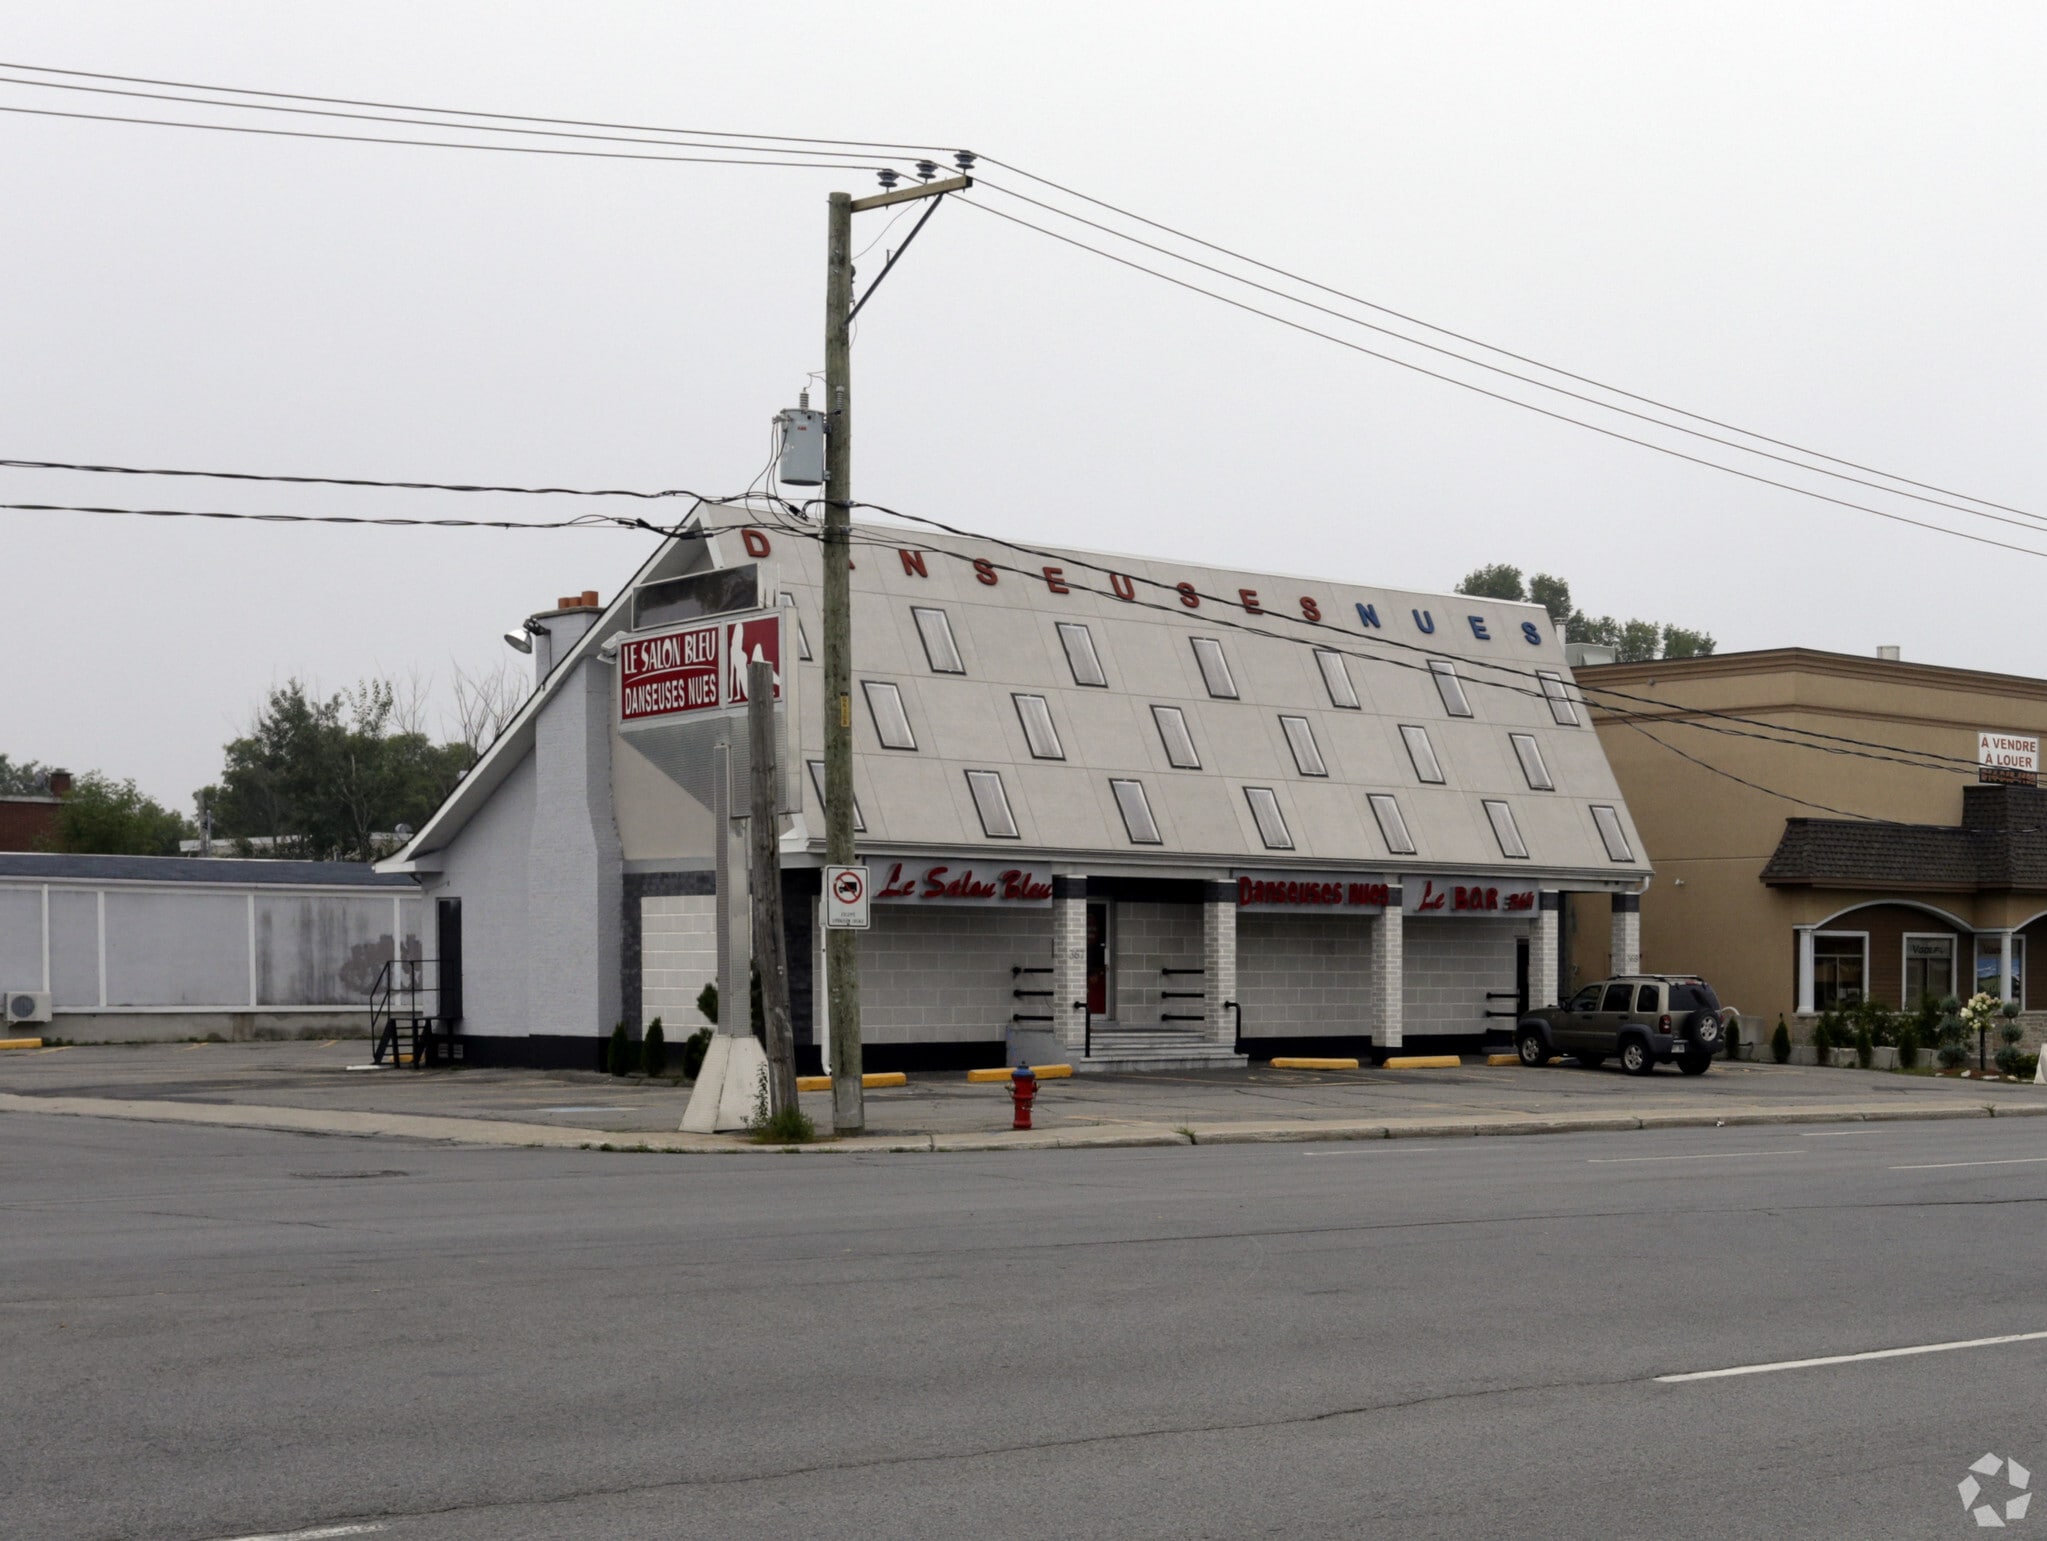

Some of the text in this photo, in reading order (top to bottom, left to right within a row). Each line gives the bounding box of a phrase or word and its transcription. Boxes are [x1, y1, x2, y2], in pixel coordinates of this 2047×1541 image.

[741, 528, 1541, 646] DNSEUSES NUES
[624, 630, 717, 674] LE SALON BLEU
[625, 673, 717, 716] DANSEUSES NUES
[1993, 738, 2036, 753] VENDRE
[1997, 754, 2033, 769] LOUER
[878, 862, 1053, 900] Le Salon Bleu
[1239, 876, 1342, 906] Danseuses
[1418, 880, 1446, 912] Le
